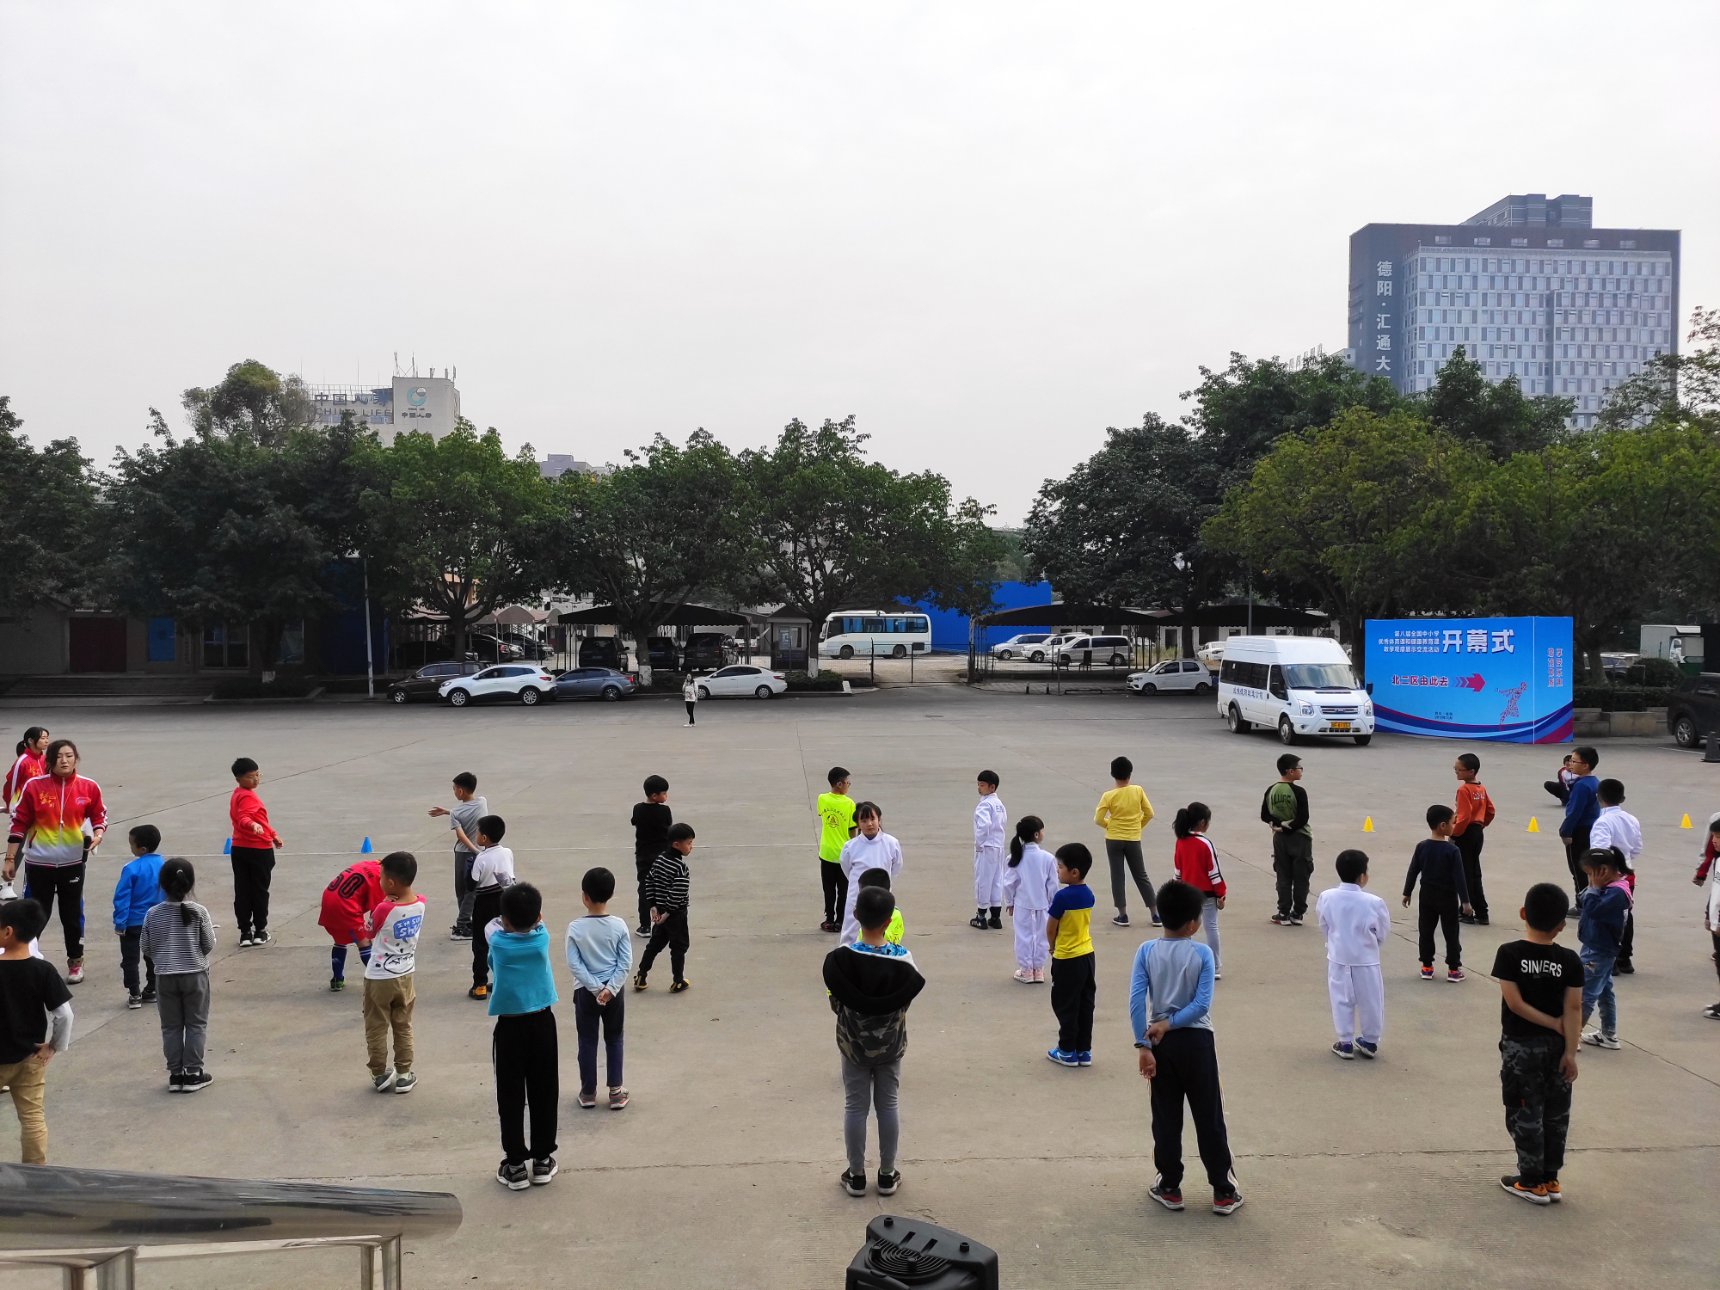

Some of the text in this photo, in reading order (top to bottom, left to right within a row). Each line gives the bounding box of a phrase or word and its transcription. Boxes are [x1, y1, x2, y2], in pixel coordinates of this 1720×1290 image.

[1376, 260, 1392, 378] 德阳·汇通大
[1442, 629, 1515, 654] 开幕式
[1392, 674, 1449, 687] 北二区由此去
